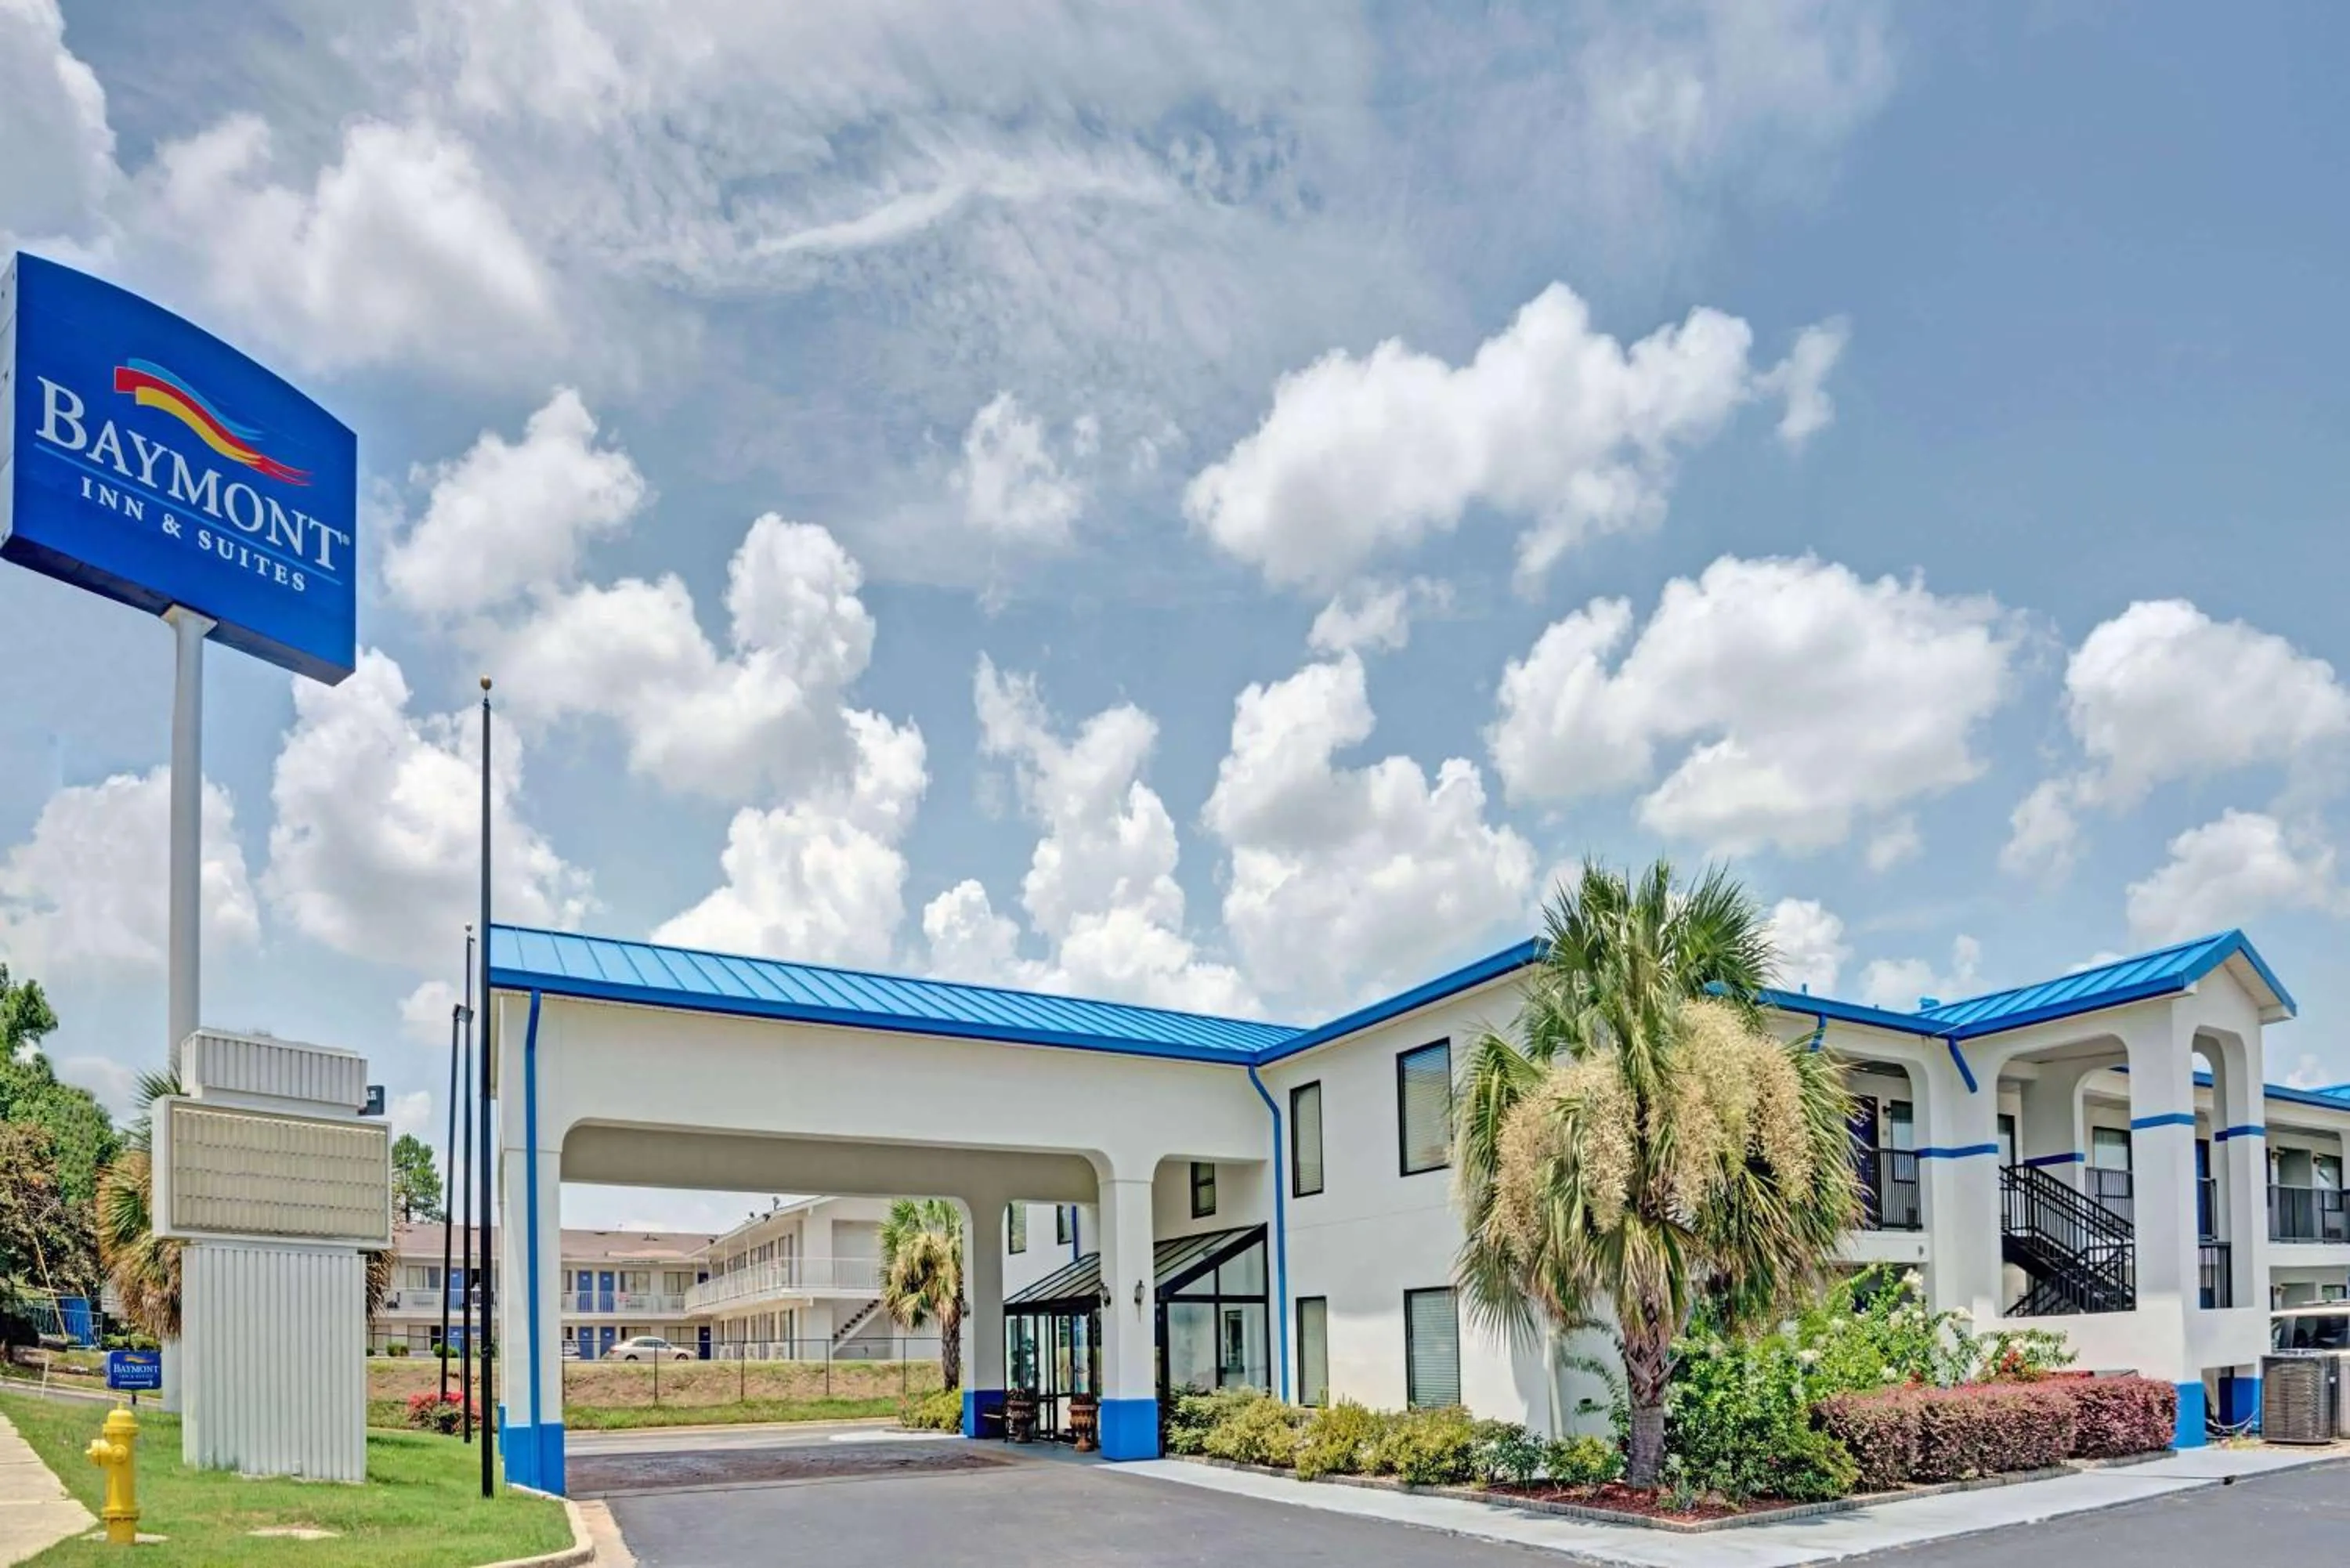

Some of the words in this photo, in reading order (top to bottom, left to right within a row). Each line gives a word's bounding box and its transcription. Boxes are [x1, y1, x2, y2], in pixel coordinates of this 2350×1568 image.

[36, 376, 342, 571] BAYMONT
[81, 476, 144, 522] INN
[162, 513, 183, 540] &
[198, 529, 306, 592] SUITES
[114, 1363, 160, 1373] BAYMONT
